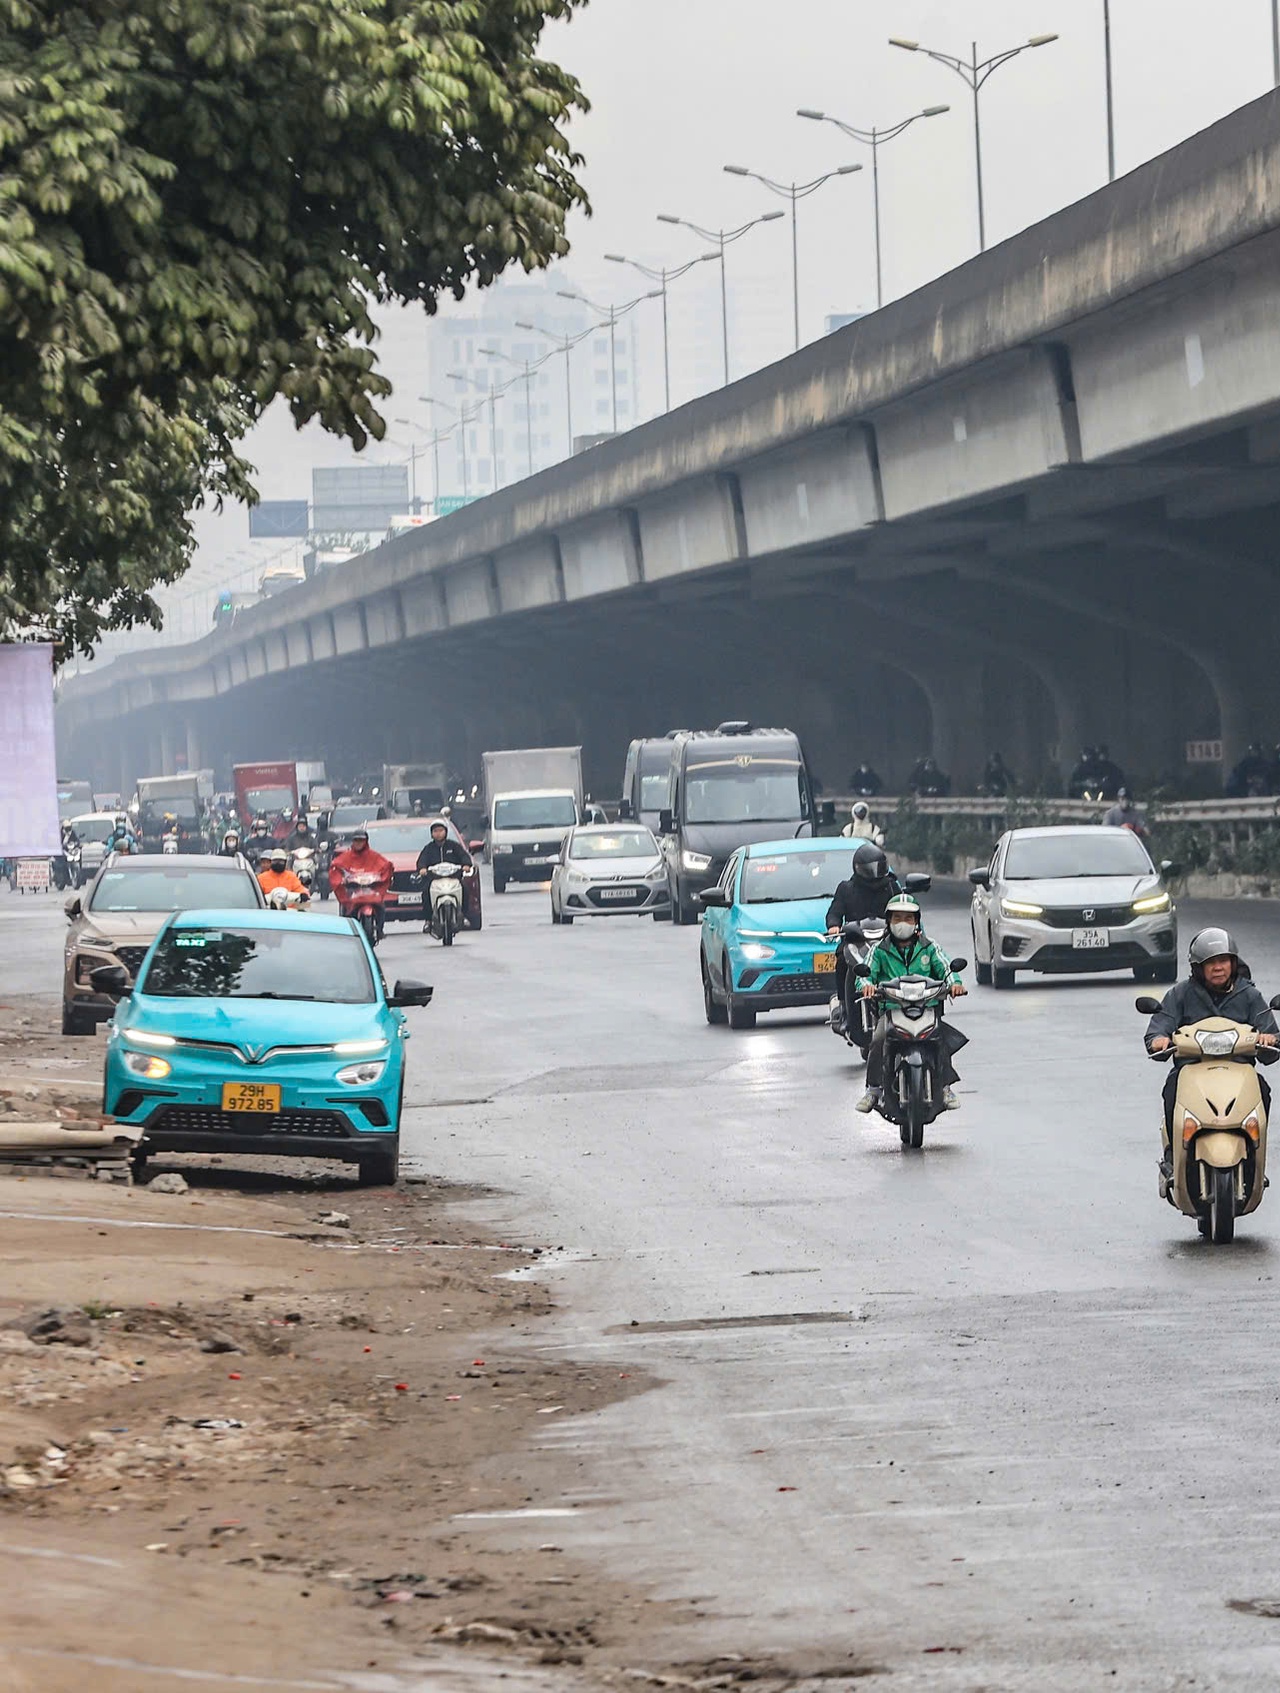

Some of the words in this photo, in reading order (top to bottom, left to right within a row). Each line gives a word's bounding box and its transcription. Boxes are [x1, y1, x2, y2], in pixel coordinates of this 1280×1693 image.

[1083, 930, 1099, 938] 35A
[176, 939, 206, 947] TAXI
[240, 1085, 264, 1097] 29H
[228, 1098, 274, 1110] 972.85
